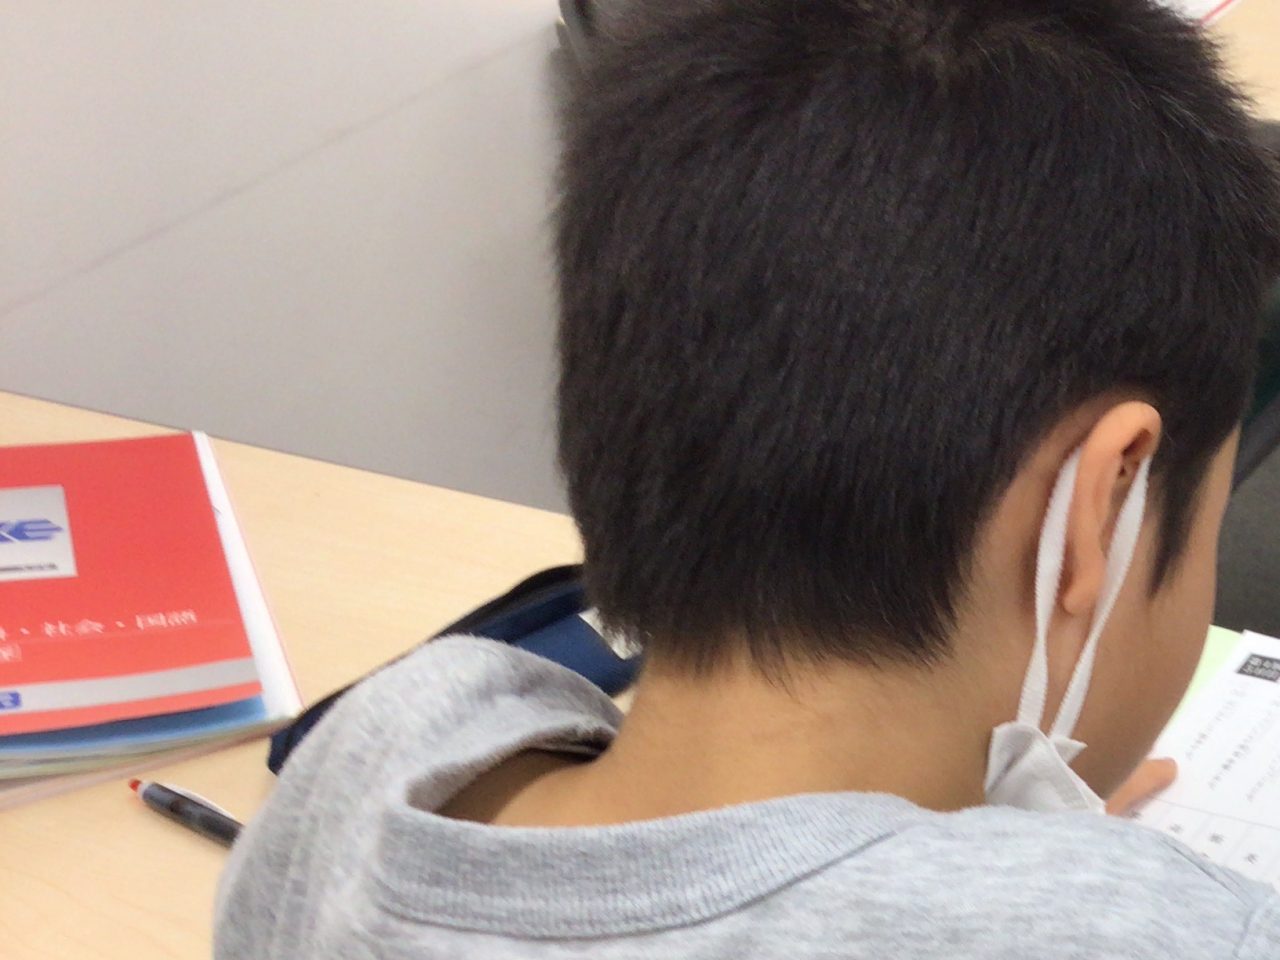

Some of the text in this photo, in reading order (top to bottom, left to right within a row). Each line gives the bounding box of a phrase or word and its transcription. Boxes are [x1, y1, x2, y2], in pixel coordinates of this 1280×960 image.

[0, 609, 197, 641] ・社会・国語
